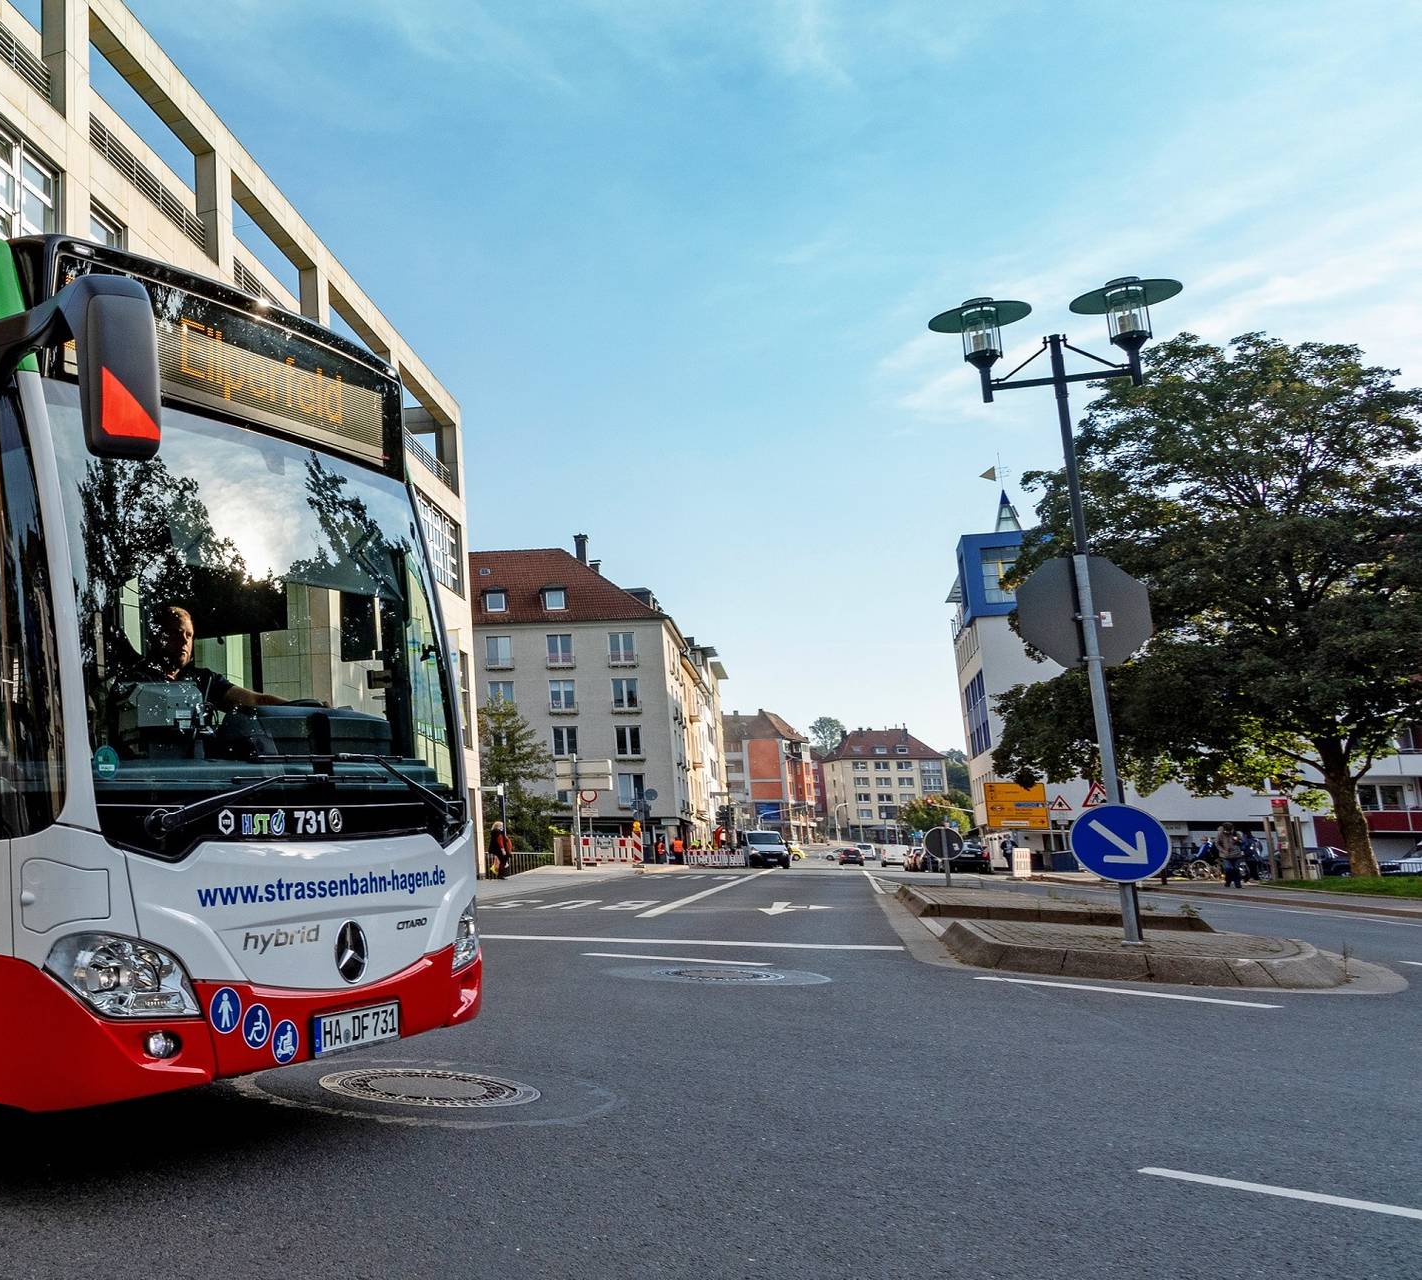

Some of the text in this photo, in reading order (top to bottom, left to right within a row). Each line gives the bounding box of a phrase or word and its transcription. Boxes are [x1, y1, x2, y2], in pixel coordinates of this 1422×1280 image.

[179, 317, 343, 425] Eilperfeld
[241, 813, 270, 835] HST
[293, 810, 326, 834] 731
[197, 864, 447, 908] www.strassenbahn-hagen.de
[242, 923, 321, 955] hybrid
[396, 917, 428, 930] CITARO
[323, 1019, 342, 1048] HA
[352, 1013, 369, 1041] DF
[372, 1007, 396, 1037] 731
